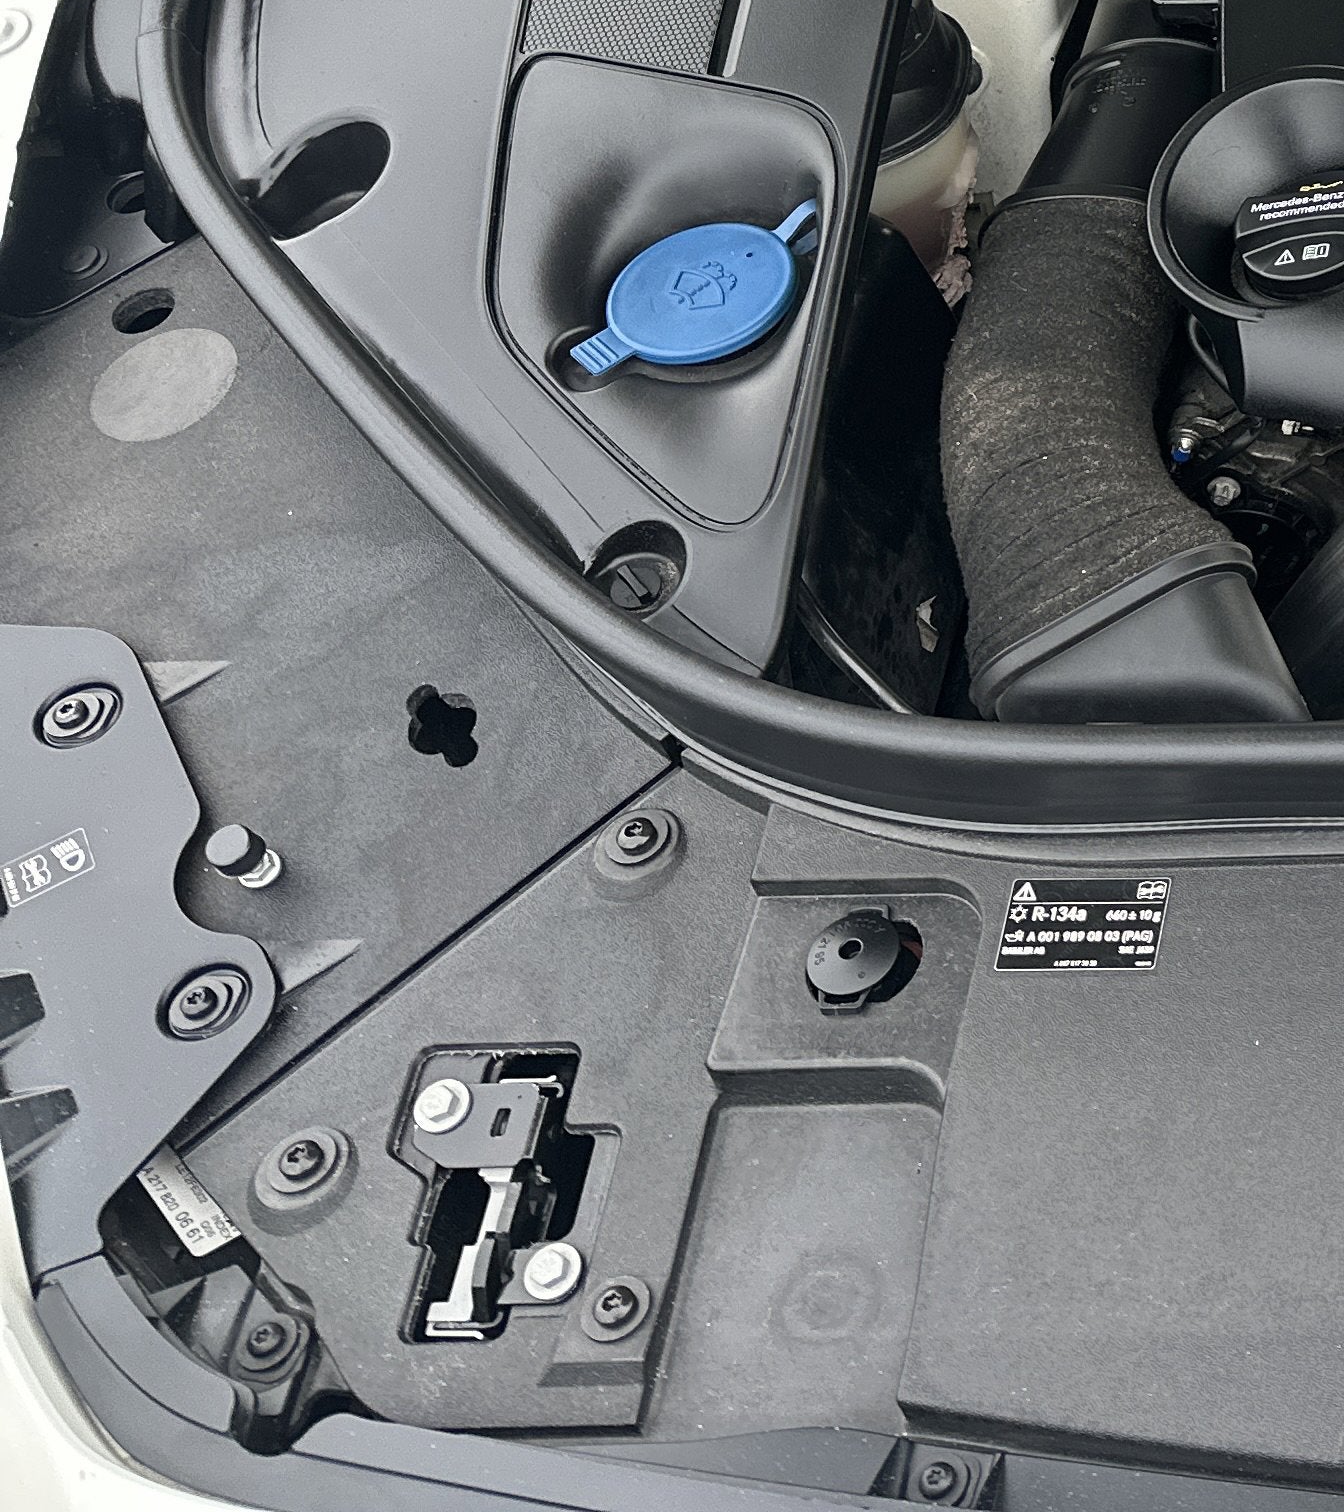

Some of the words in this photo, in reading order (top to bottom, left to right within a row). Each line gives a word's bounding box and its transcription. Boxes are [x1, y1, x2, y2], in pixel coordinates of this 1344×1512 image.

[1250, 191, 1344, 213] Mercedes-Benz
[1031, 906, 1088, 922] R-134a
[1140, 910, 1152, 921] 10
[1026, 932, 1036, 942] A
[1038, 931, 1060, 942] 001
[1121, 929, 1154, 943] (PAG)
[148, 1175, 169, 1193] 217
[175, 1210, 194, 1229] 06
[186, 1227, 205, 1244] 61
[211, 1213, 233, 1240] INDEX
